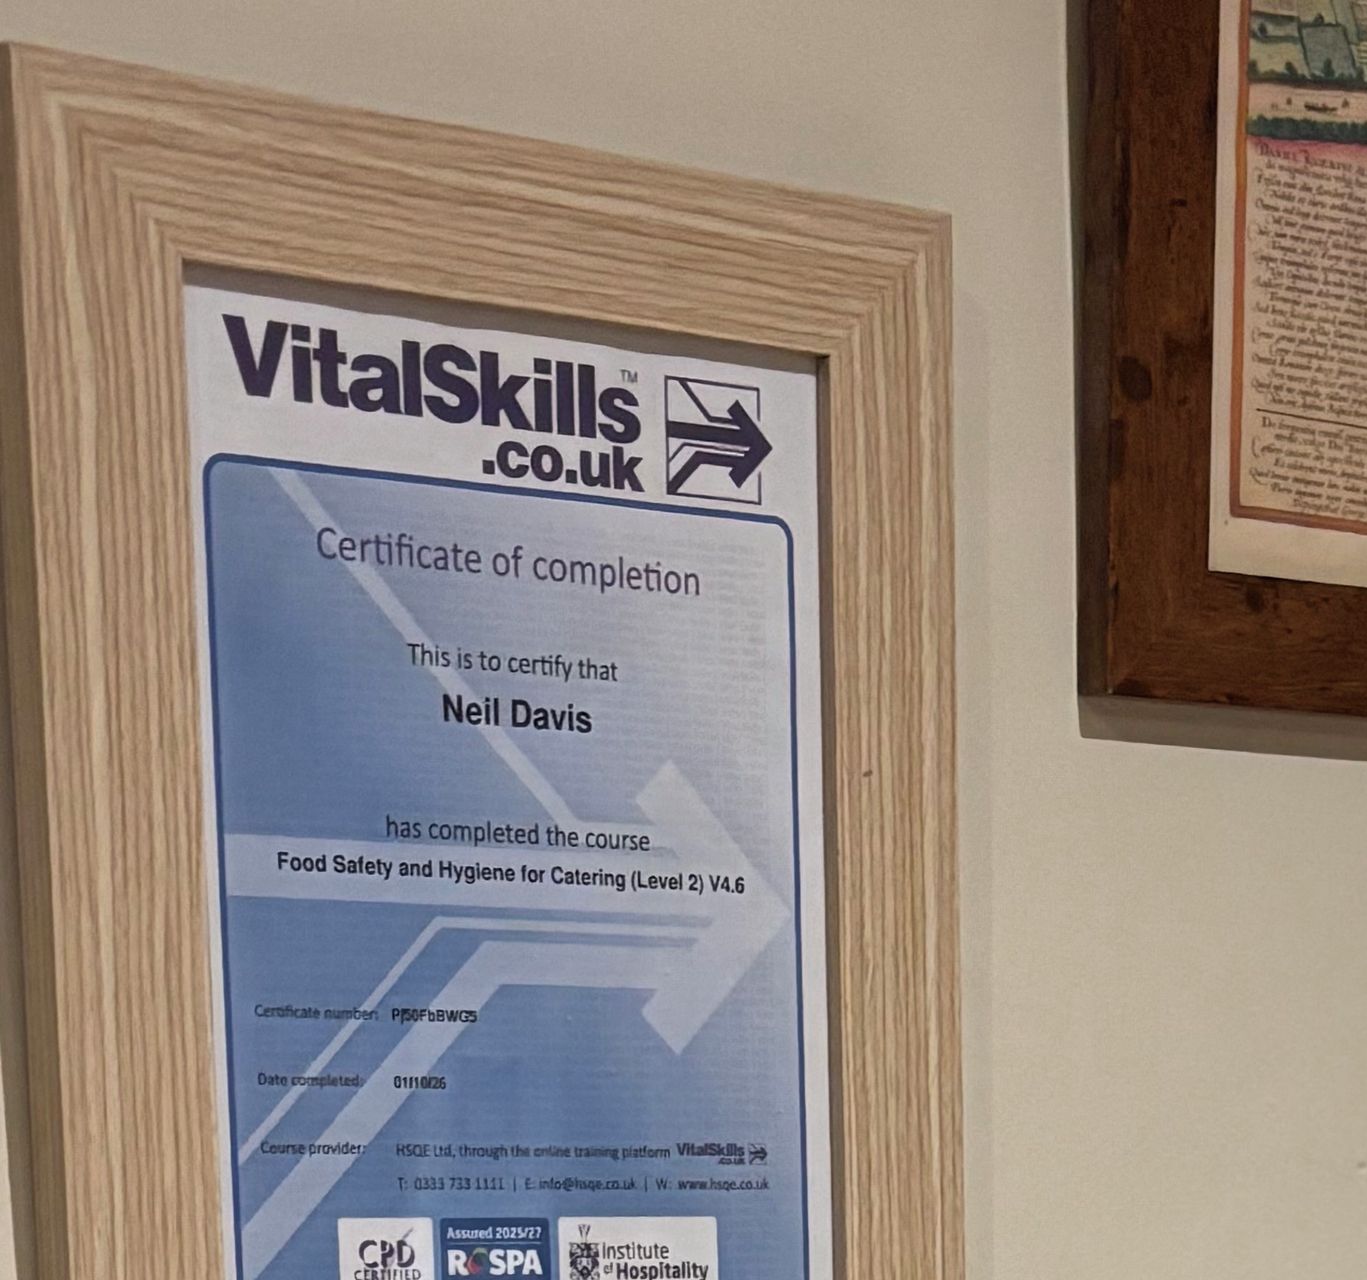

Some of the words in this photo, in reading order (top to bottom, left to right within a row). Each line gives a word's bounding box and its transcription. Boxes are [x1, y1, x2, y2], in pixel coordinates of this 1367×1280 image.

[222, 313, 641, 444] VitalSkills
[482, 440, 645, 493] .co.uk
[316, 527, 482, 577] Certificate
[491, 546, 524, 578] of
[532, 555, 701, 597] completion
[407, 642, 451, 668] This
[456, 646, 474, 670] is
[478, 649, 502, 673] to
[506, 652, 573, 682] certify
[577, 657, 618, 682] that
[441, 694, 500, 727] Neil
[510, 699, 593, 733] Davis
[385, 814, 422, 840] has
[428, 818, 540, 847] completed
[545, 824, 580, 848] the
[586, 829, 651, 851] course
[276, 852, 327, 873] Food
[332, 854, 393, 880] Safety
[398, 858, 433, 879] and
[438, 861, 516, 886] Hygiene
[521, 864, 545, 885] for
[550, 865, 626, 892] Catering
[630, 869, 684, 893] (Level
[687, 873, 705, 895] 2)
[709, 875, 746, 895] V4.6
[254, 1004, 321, 1019] Certificate
[324, 1007, 379, 1021] number:
[258, 1073, 287, 1086] Date
[260, 1141, 306, 1154] Course
[308, 1141, 366, 1157] provider:
[459, 1143, 507, 1160] through
[511, 1144, 530, 1157] the
[574, 1145, 619, 1161] training
[622, 1144, 670, 1160] platform
[676, 1143, 745, 1157] VitalSkills
[447, 1227, 493, 1240] Assured
[359, 1240, 415, 1268] CPD
[603, 1242, 670, 1260] Institute
